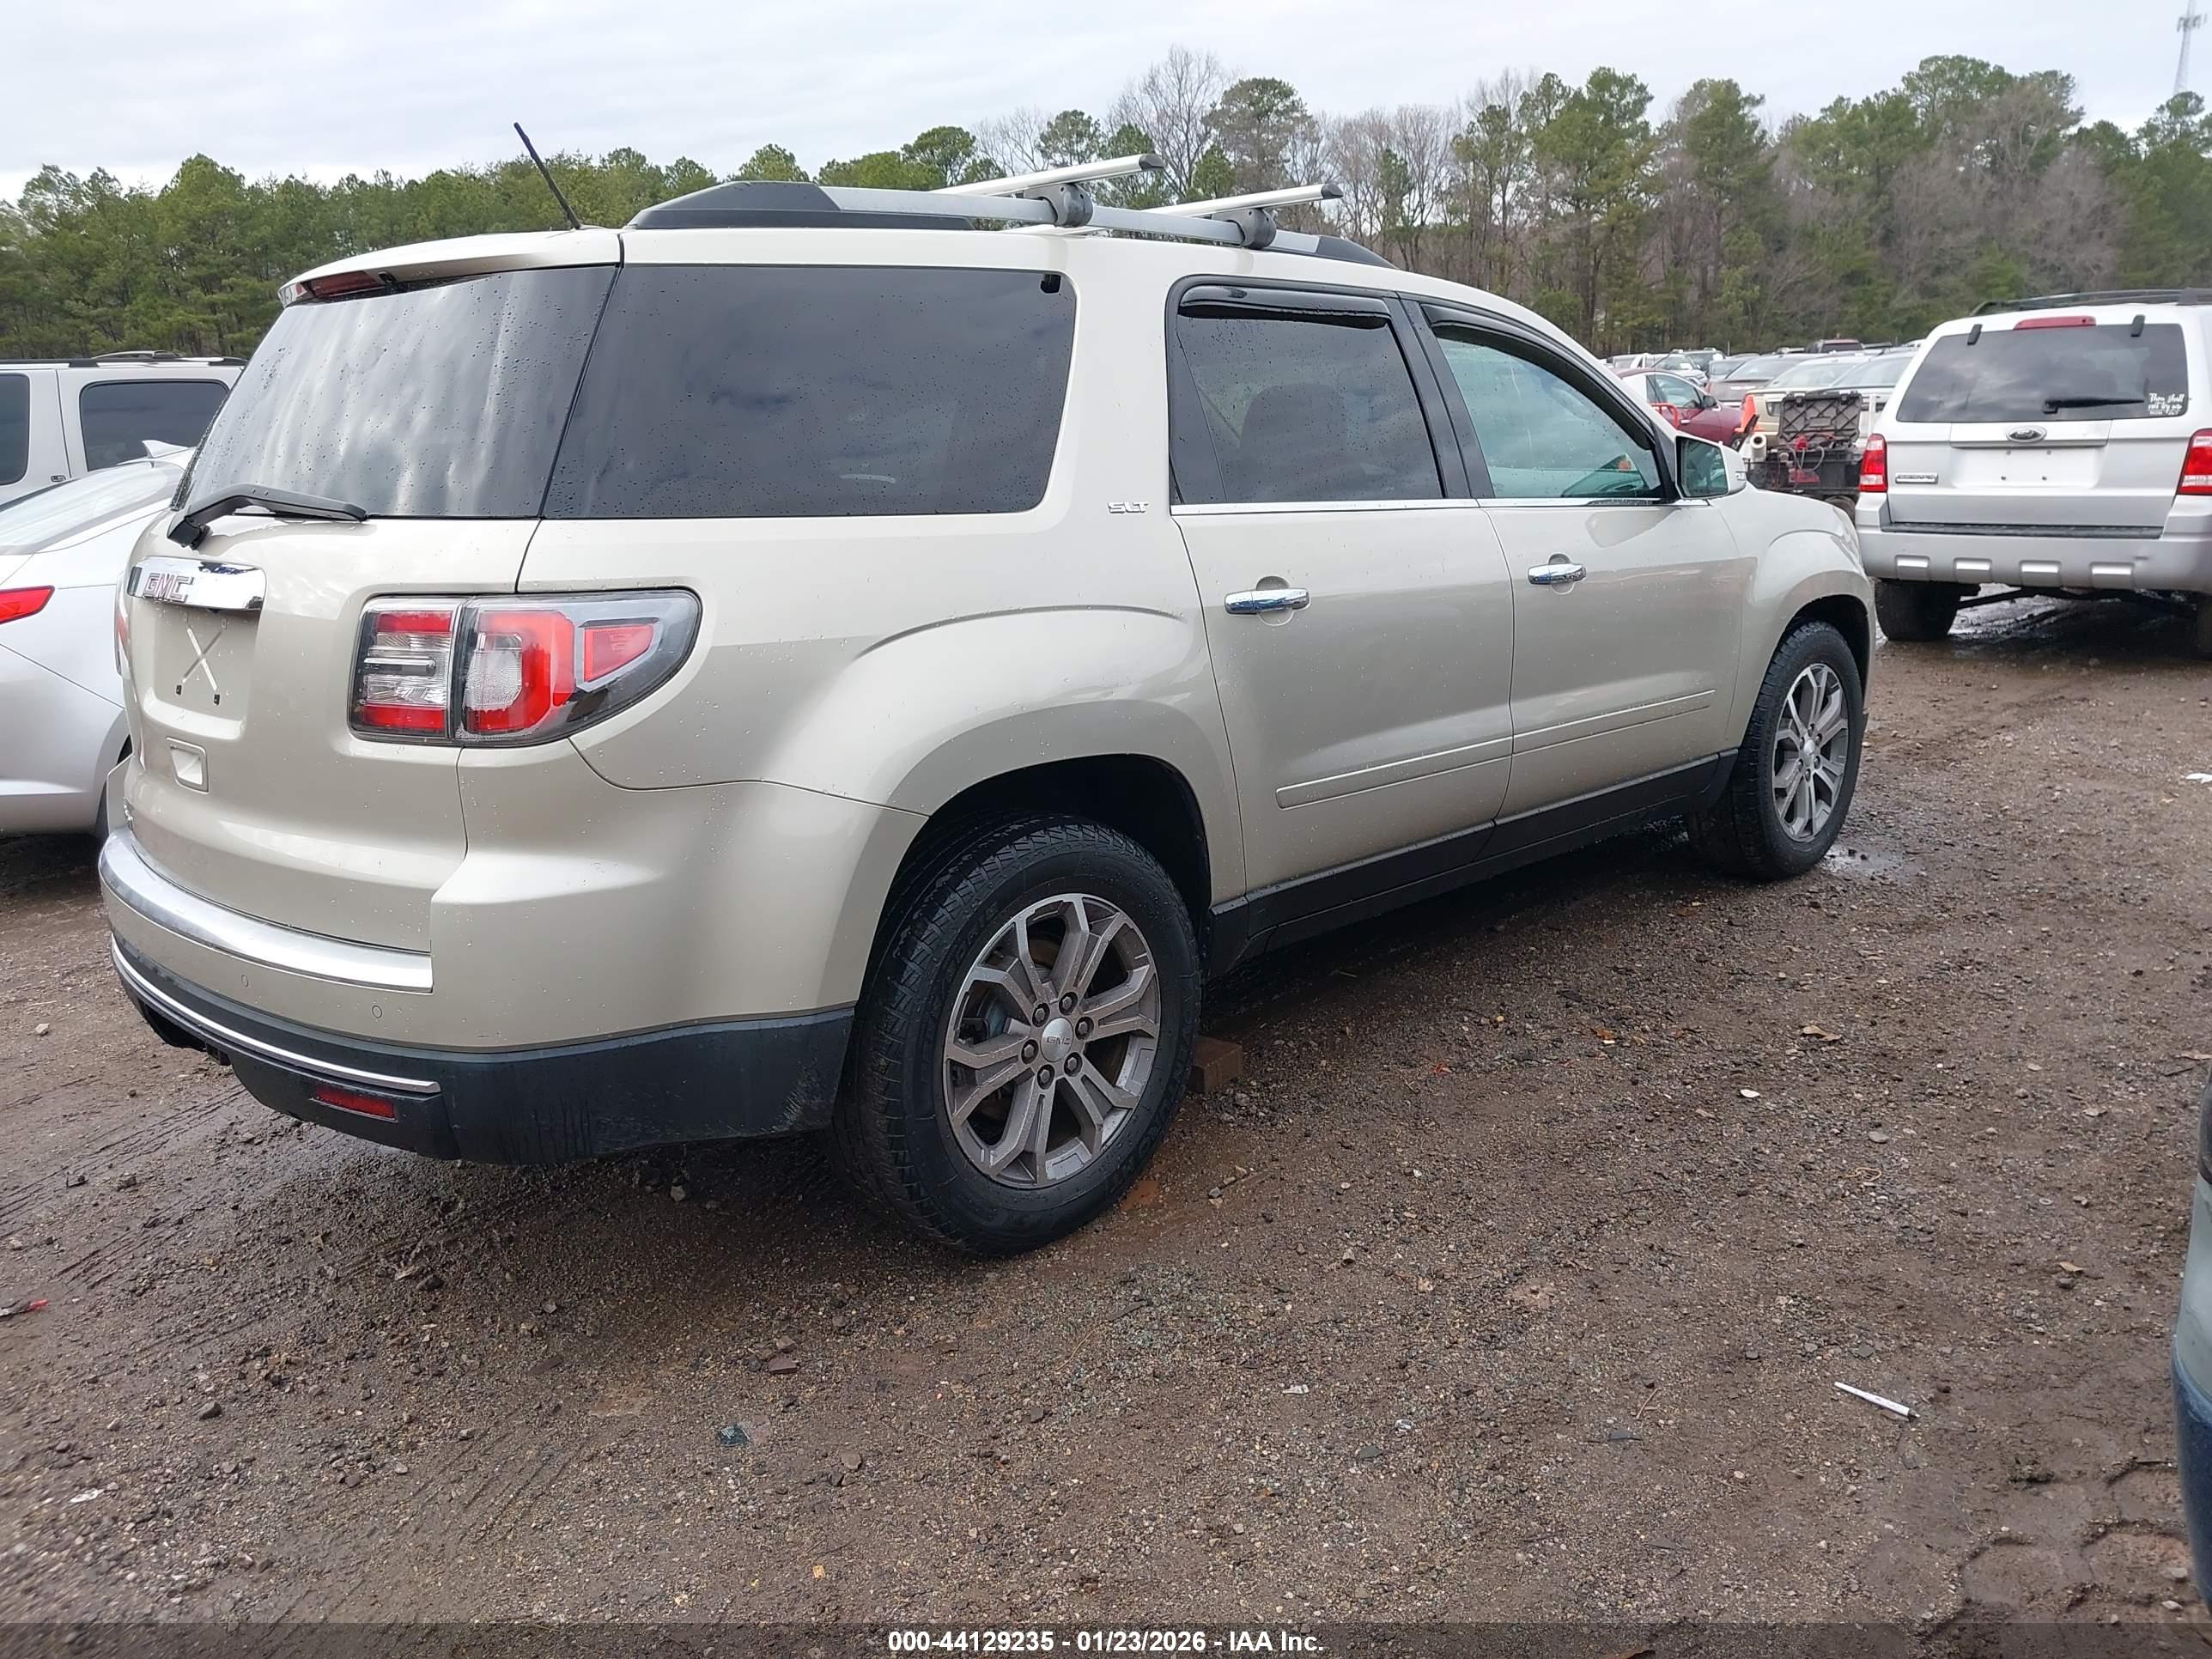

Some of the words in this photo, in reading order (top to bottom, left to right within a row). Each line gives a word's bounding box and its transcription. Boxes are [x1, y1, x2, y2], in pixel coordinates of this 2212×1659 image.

[1108, 501, 1149, 515] SLT
[143, 572, 195, 603] GMC
[1046, 1036, 1072, 1045] GMC
